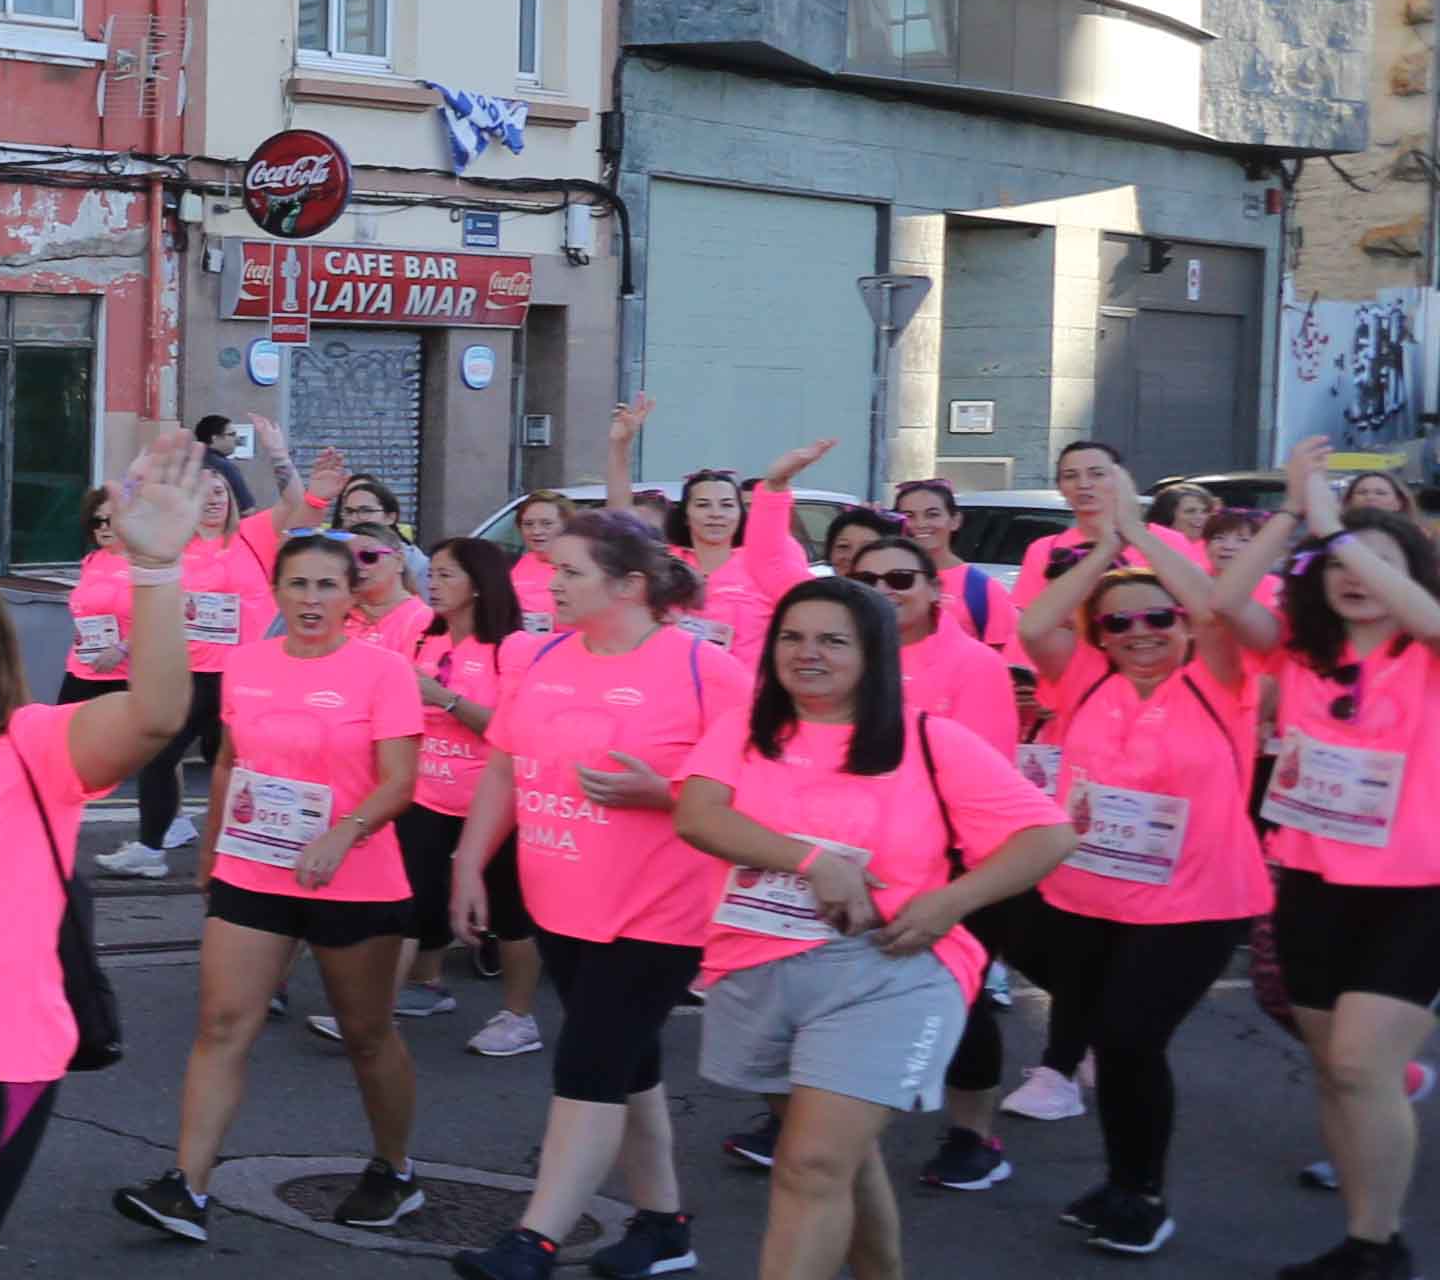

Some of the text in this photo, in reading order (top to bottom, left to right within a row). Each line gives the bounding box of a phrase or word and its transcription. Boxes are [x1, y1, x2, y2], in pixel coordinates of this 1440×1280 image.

[324, 251, 459, 281] CAFE BAR
[403, 284, 478, 317] MAR
[257, 808, 291, 826] 016
